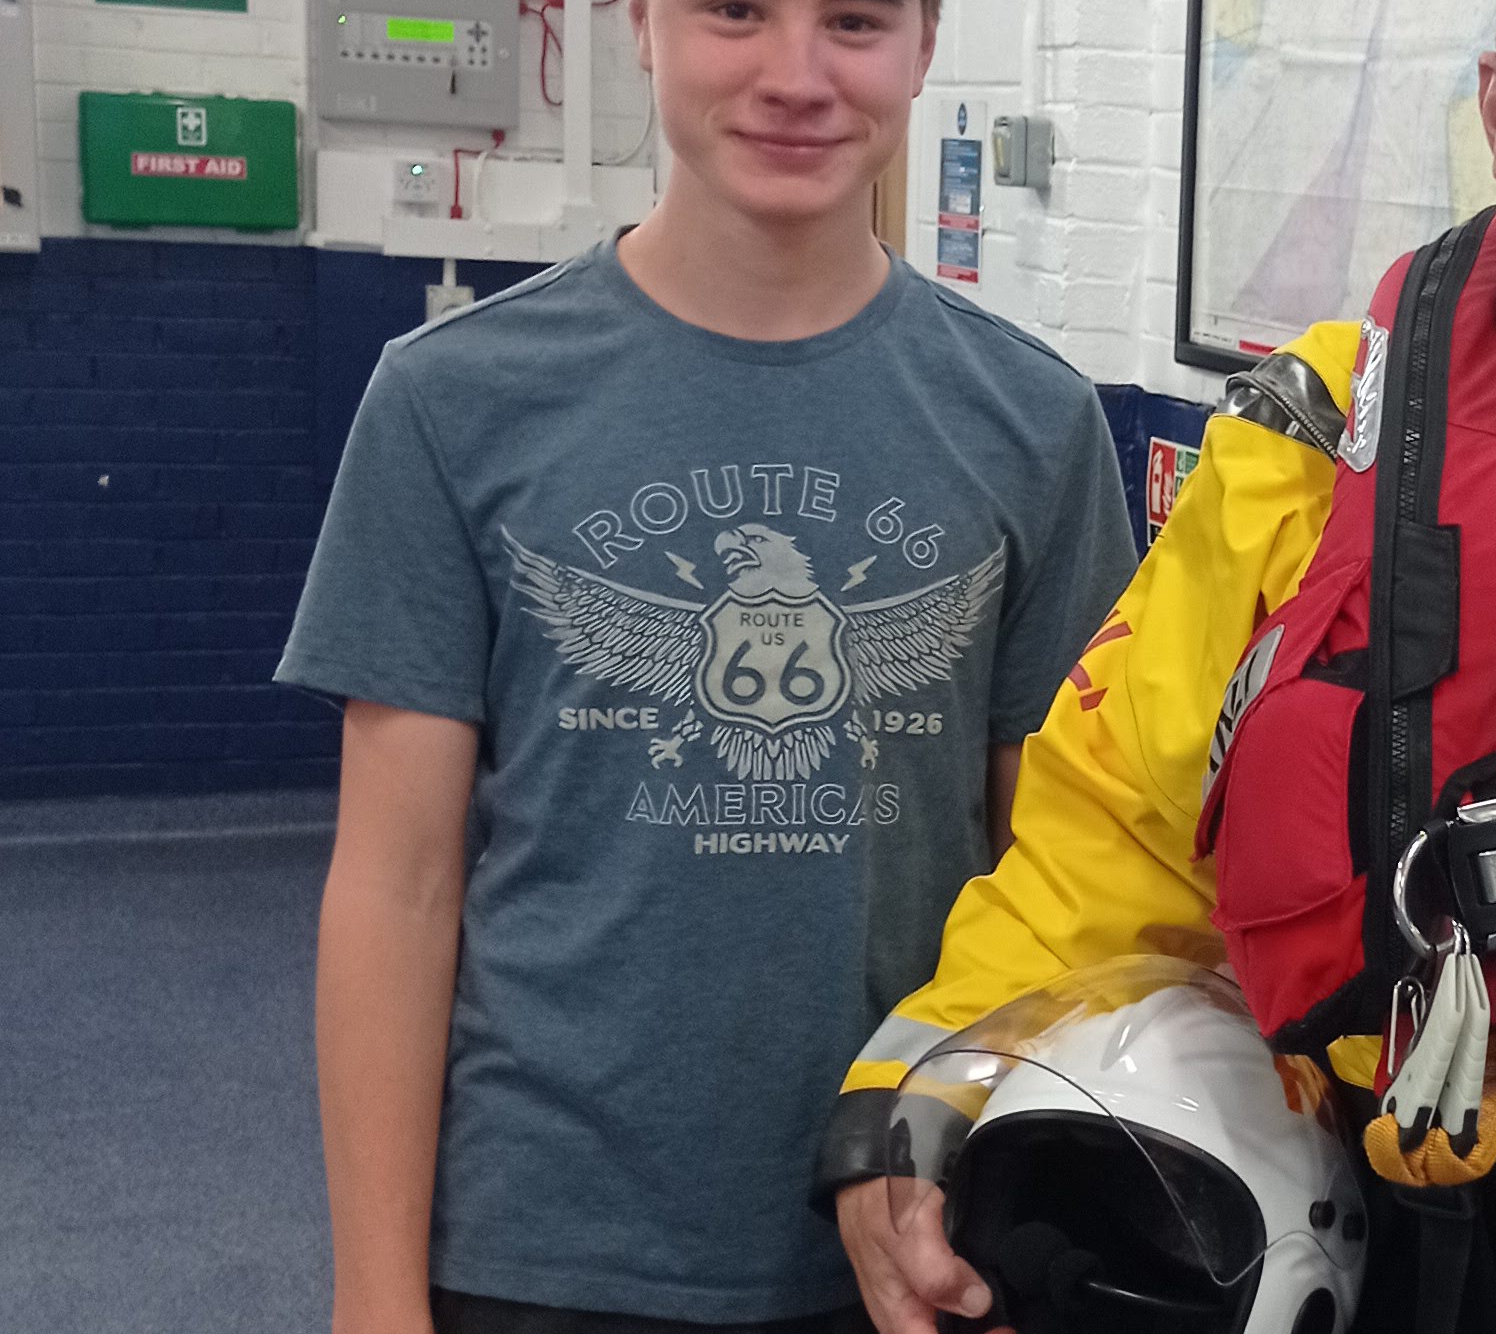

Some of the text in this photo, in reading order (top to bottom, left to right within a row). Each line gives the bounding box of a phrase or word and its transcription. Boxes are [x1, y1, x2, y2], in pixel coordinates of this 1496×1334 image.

[135, 155, 242, 179] FIRST AID
[572, 464, 945, 569] ROUTE 66
[739, 612, 805, 629] ROUTE
[761, 632, 785, 647] US
[722, 639, 825, 707] 66
[558, 707, 659, 731] SINCE
[872, 708, 943, 734] 1926
[694, 832, 851, 855] HIGHWAY
